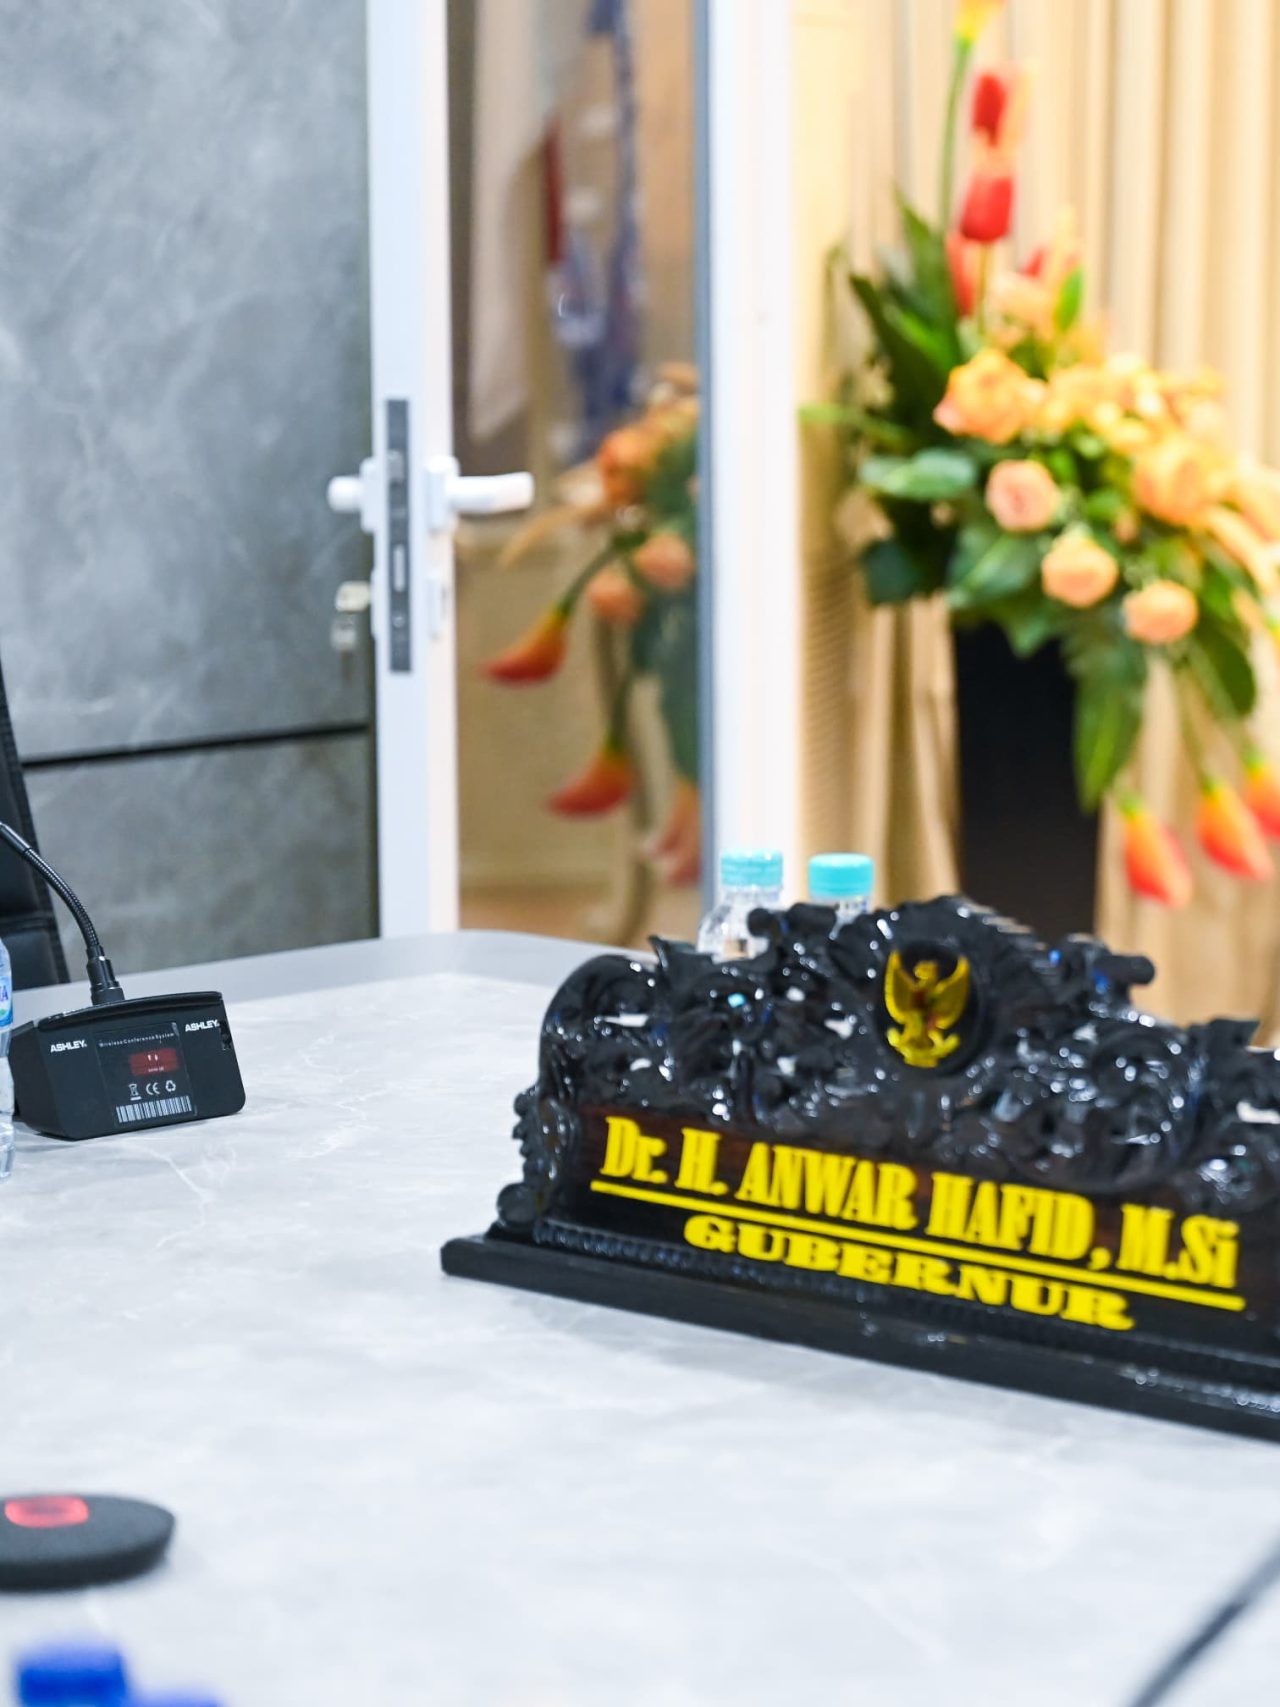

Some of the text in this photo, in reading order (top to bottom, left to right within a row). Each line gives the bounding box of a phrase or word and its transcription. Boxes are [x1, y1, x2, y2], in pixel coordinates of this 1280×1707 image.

[50, 1040, 86, 1053] ASHLEY
[184, 1019, 218, 1032] ASHLEY
[600, 1116, 1240, 1289] Dr. H. ANWAR HAFID, M.Si
[684, 1214, 1136, 1331] GUBERNUR
